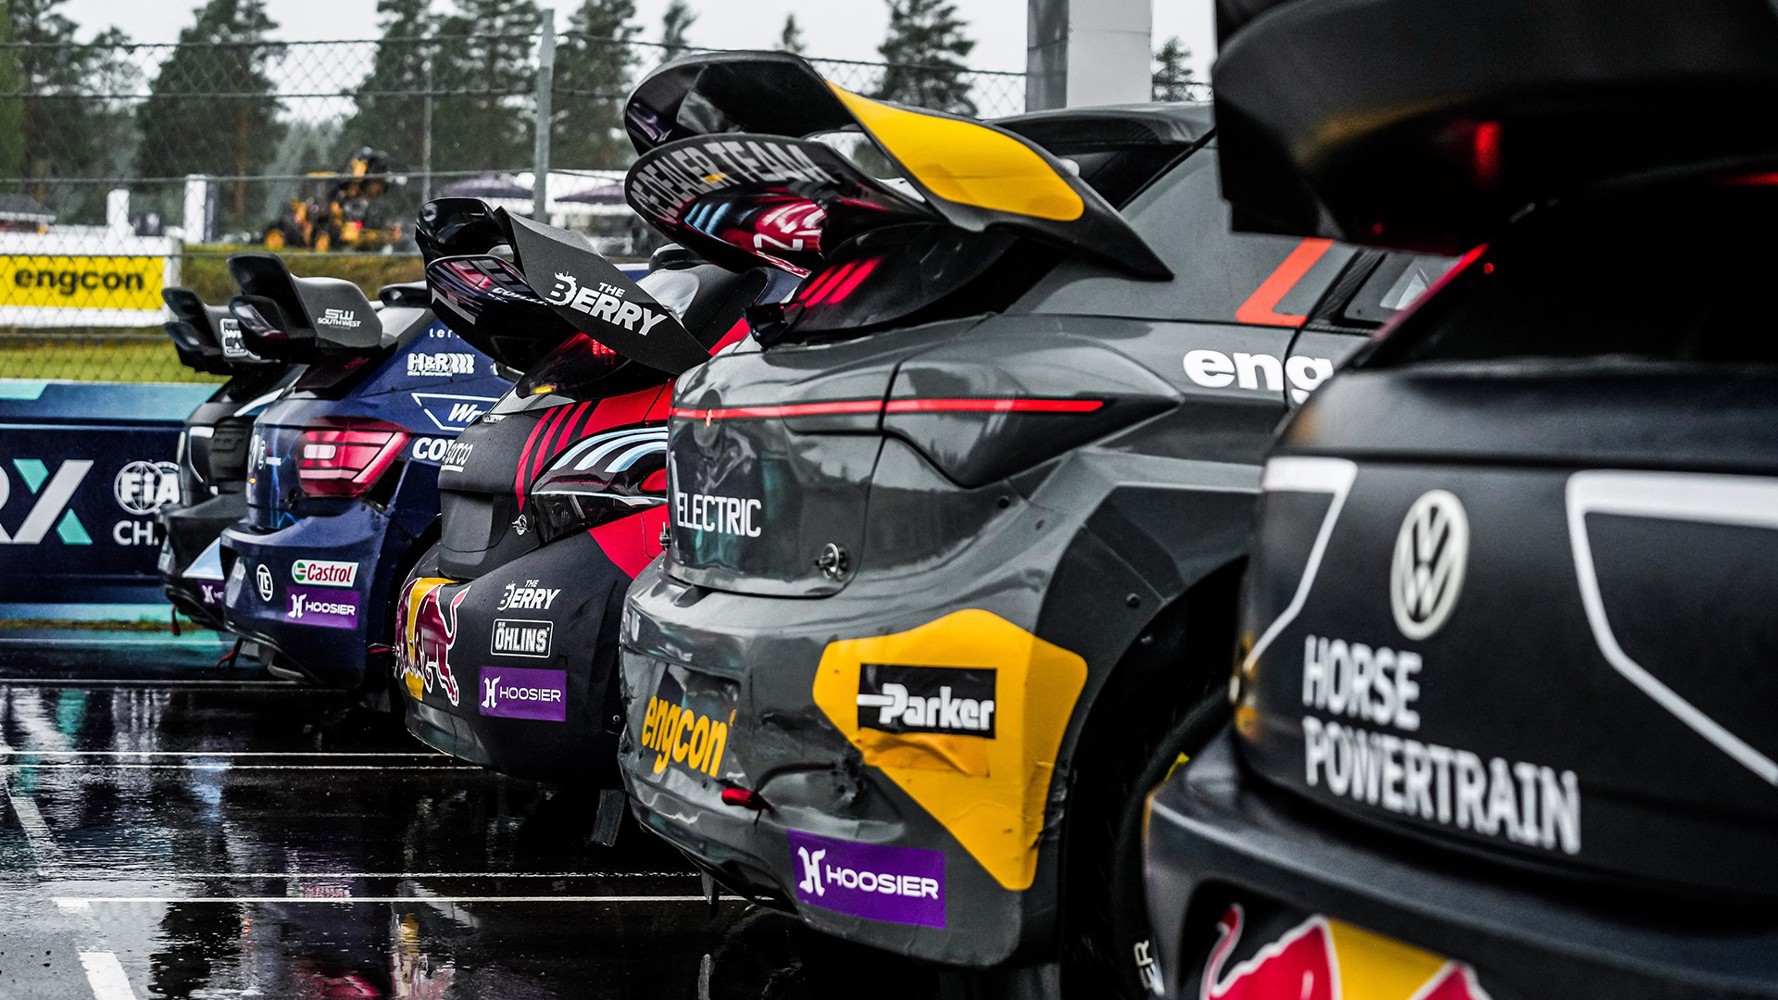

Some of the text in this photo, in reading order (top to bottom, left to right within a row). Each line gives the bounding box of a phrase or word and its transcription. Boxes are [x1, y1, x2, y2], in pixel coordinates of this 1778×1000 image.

[704, 141, 838, 185] TEAM
[14, 269, 145, 296] engcon
[598, 282, 625, 298] THE
[545, 272, 668, 337] BERRY
[676, 491, 762, 537] ELECTRIC
[307, 564, 353, 583] Castrol
[525, 580, 539, 588] THE
[305, 601, 356, 616] HOOSIER
[497, 583, 561, 611] BERRY
[495, 622, 548, 653] ÖHLINS
[499, 686, 562, 703] HOOSIER
[1302, 633, 1423, 731] HORSE
[878, 682, 995, 731] Parker
[641, 693, 730, 778] engcon
[1302, 716, 1581, 854] POWERTRAIN
[826, 863, 939, 900] HOOSIER
